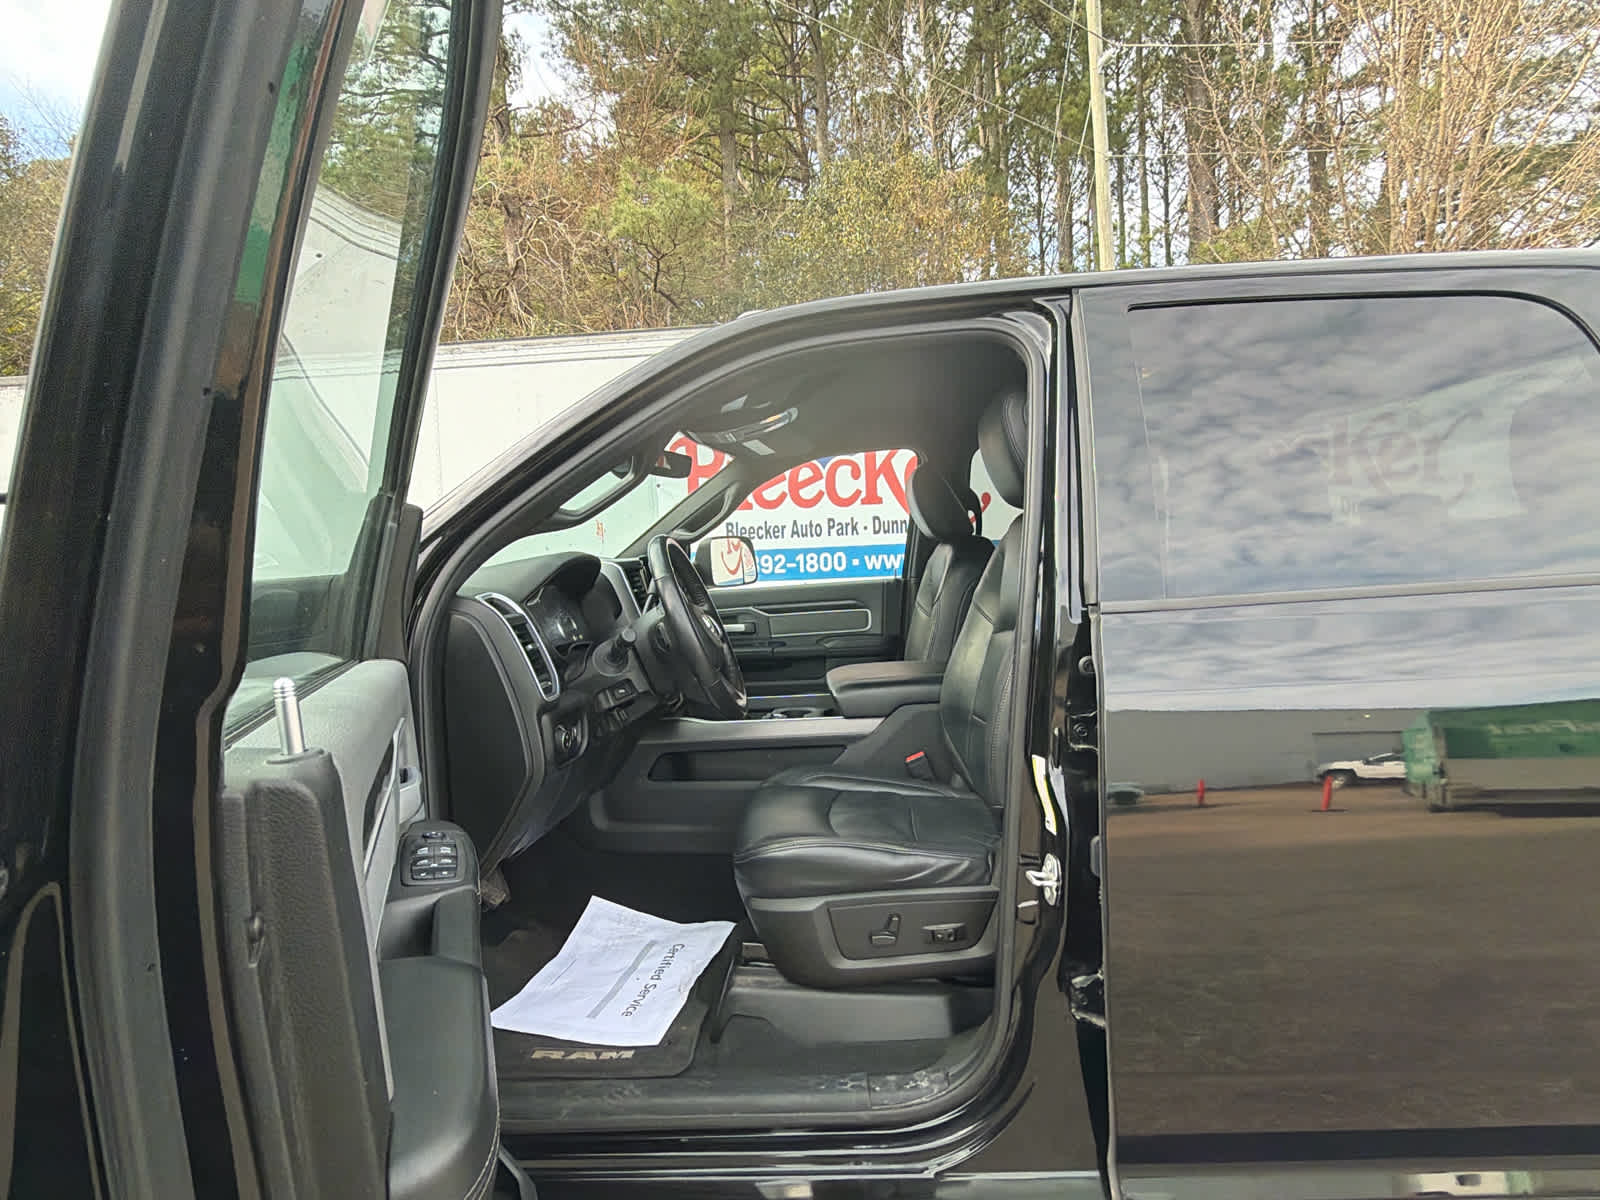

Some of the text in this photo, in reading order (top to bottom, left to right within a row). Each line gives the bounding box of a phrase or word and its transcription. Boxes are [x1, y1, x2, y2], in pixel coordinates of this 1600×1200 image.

[725, 520, 786, 540] Bleecker
[790, 519, 823, 538] Auto
[827, 516, 859, 536] Park
[756, 551, 905, 575] 92-1800 ww
[621, 944, 686, 1017] Certified Service
[531, 1049, 636, 1061] RAM
